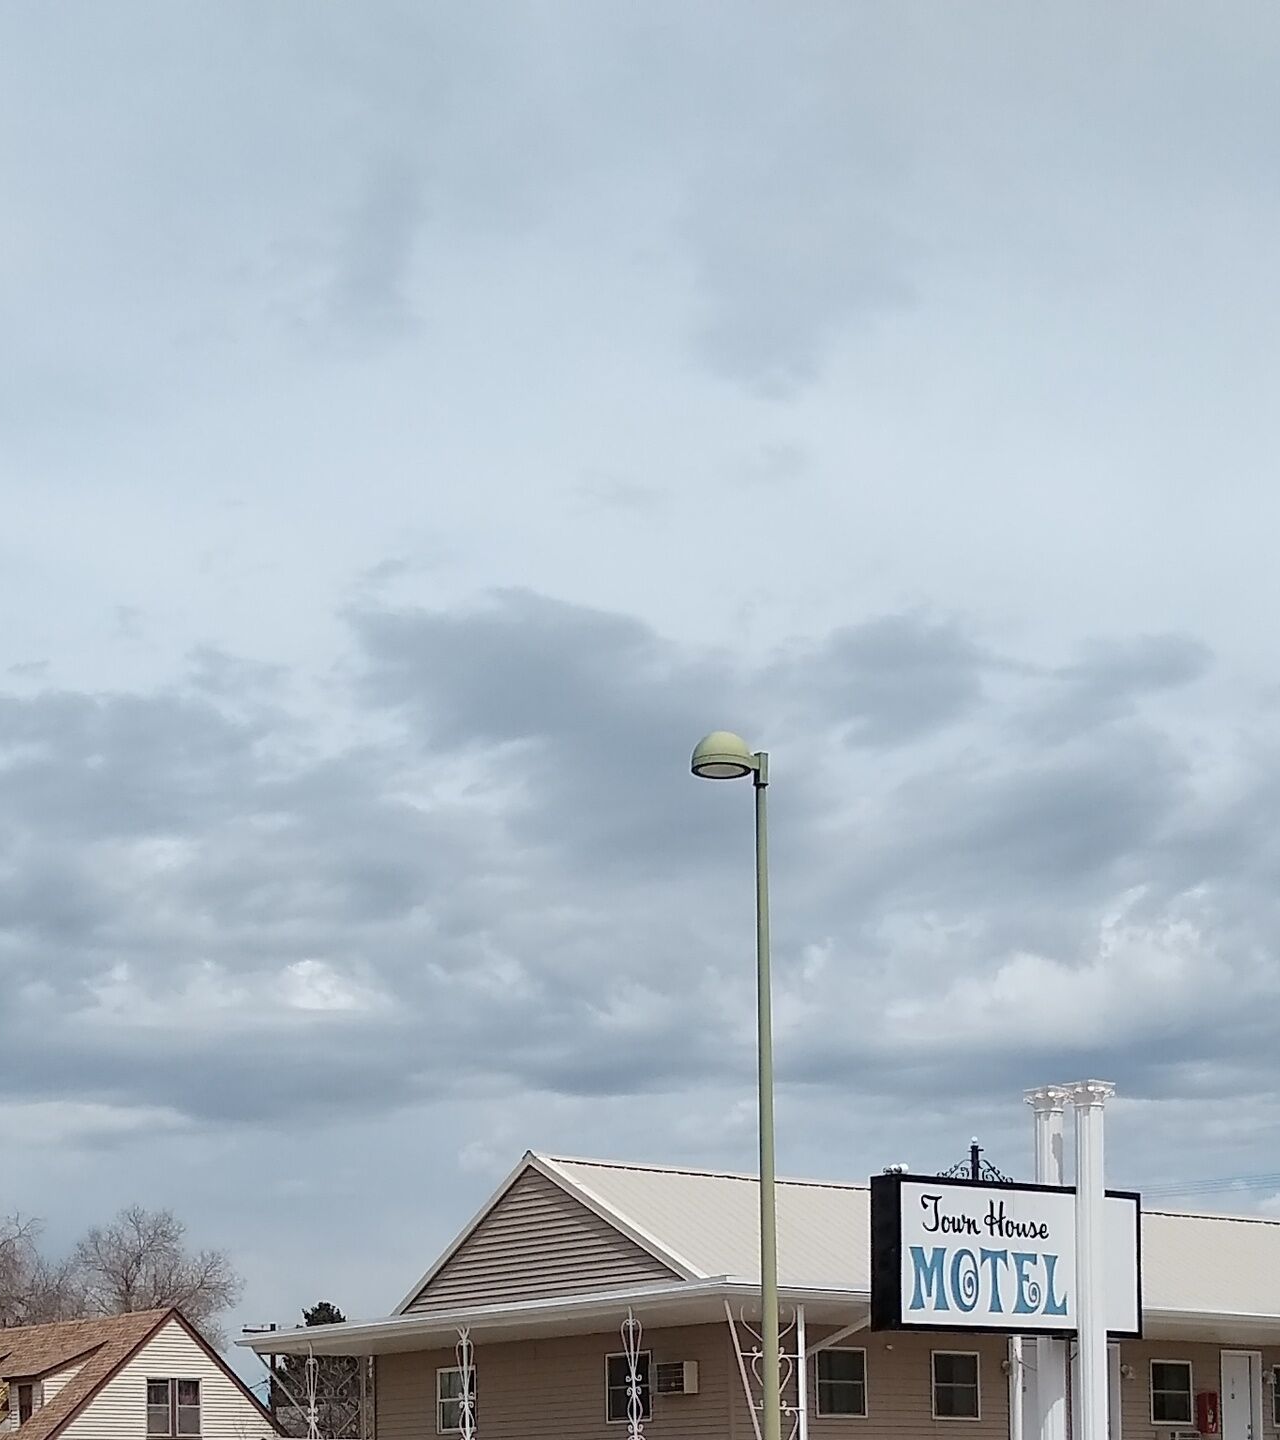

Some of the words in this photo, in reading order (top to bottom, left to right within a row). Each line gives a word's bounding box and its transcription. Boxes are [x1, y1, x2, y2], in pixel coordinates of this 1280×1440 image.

[920, 1194, 981, 1235] Town
[984, 1199, 1049, 1239] House
[908, 1246, 1068, 1316] MOTEL
